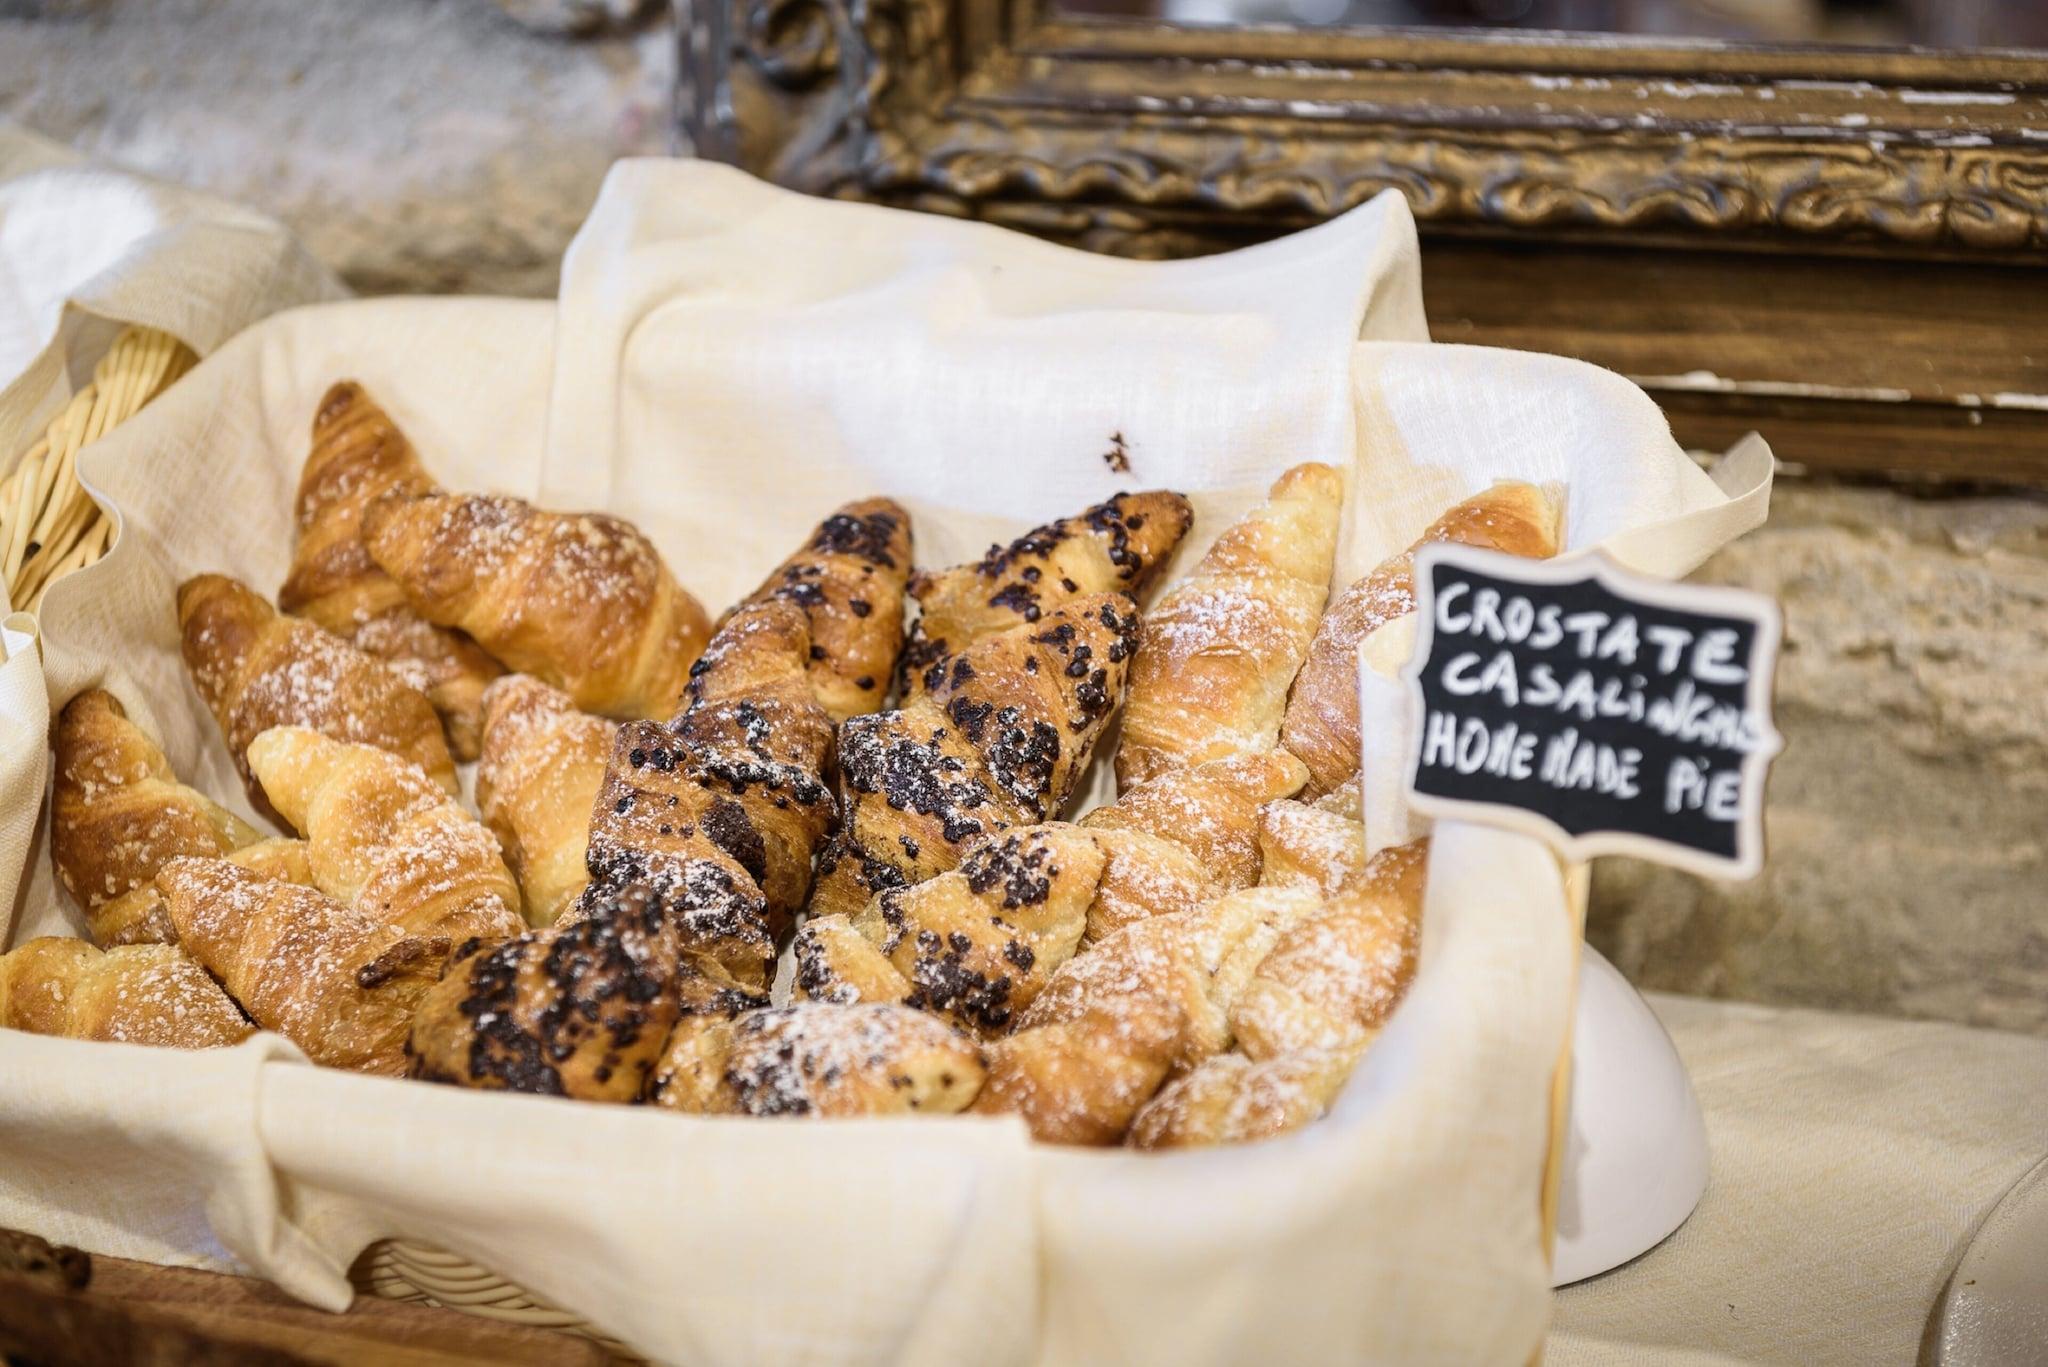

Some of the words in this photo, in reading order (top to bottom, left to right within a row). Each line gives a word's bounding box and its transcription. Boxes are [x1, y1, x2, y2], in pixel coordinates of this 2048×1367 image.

[1434, 581, 1747, 684] CROSTATE
[1423, 711, 1538, 780] HOME
[1540, 726, 1643, 799] MADE
